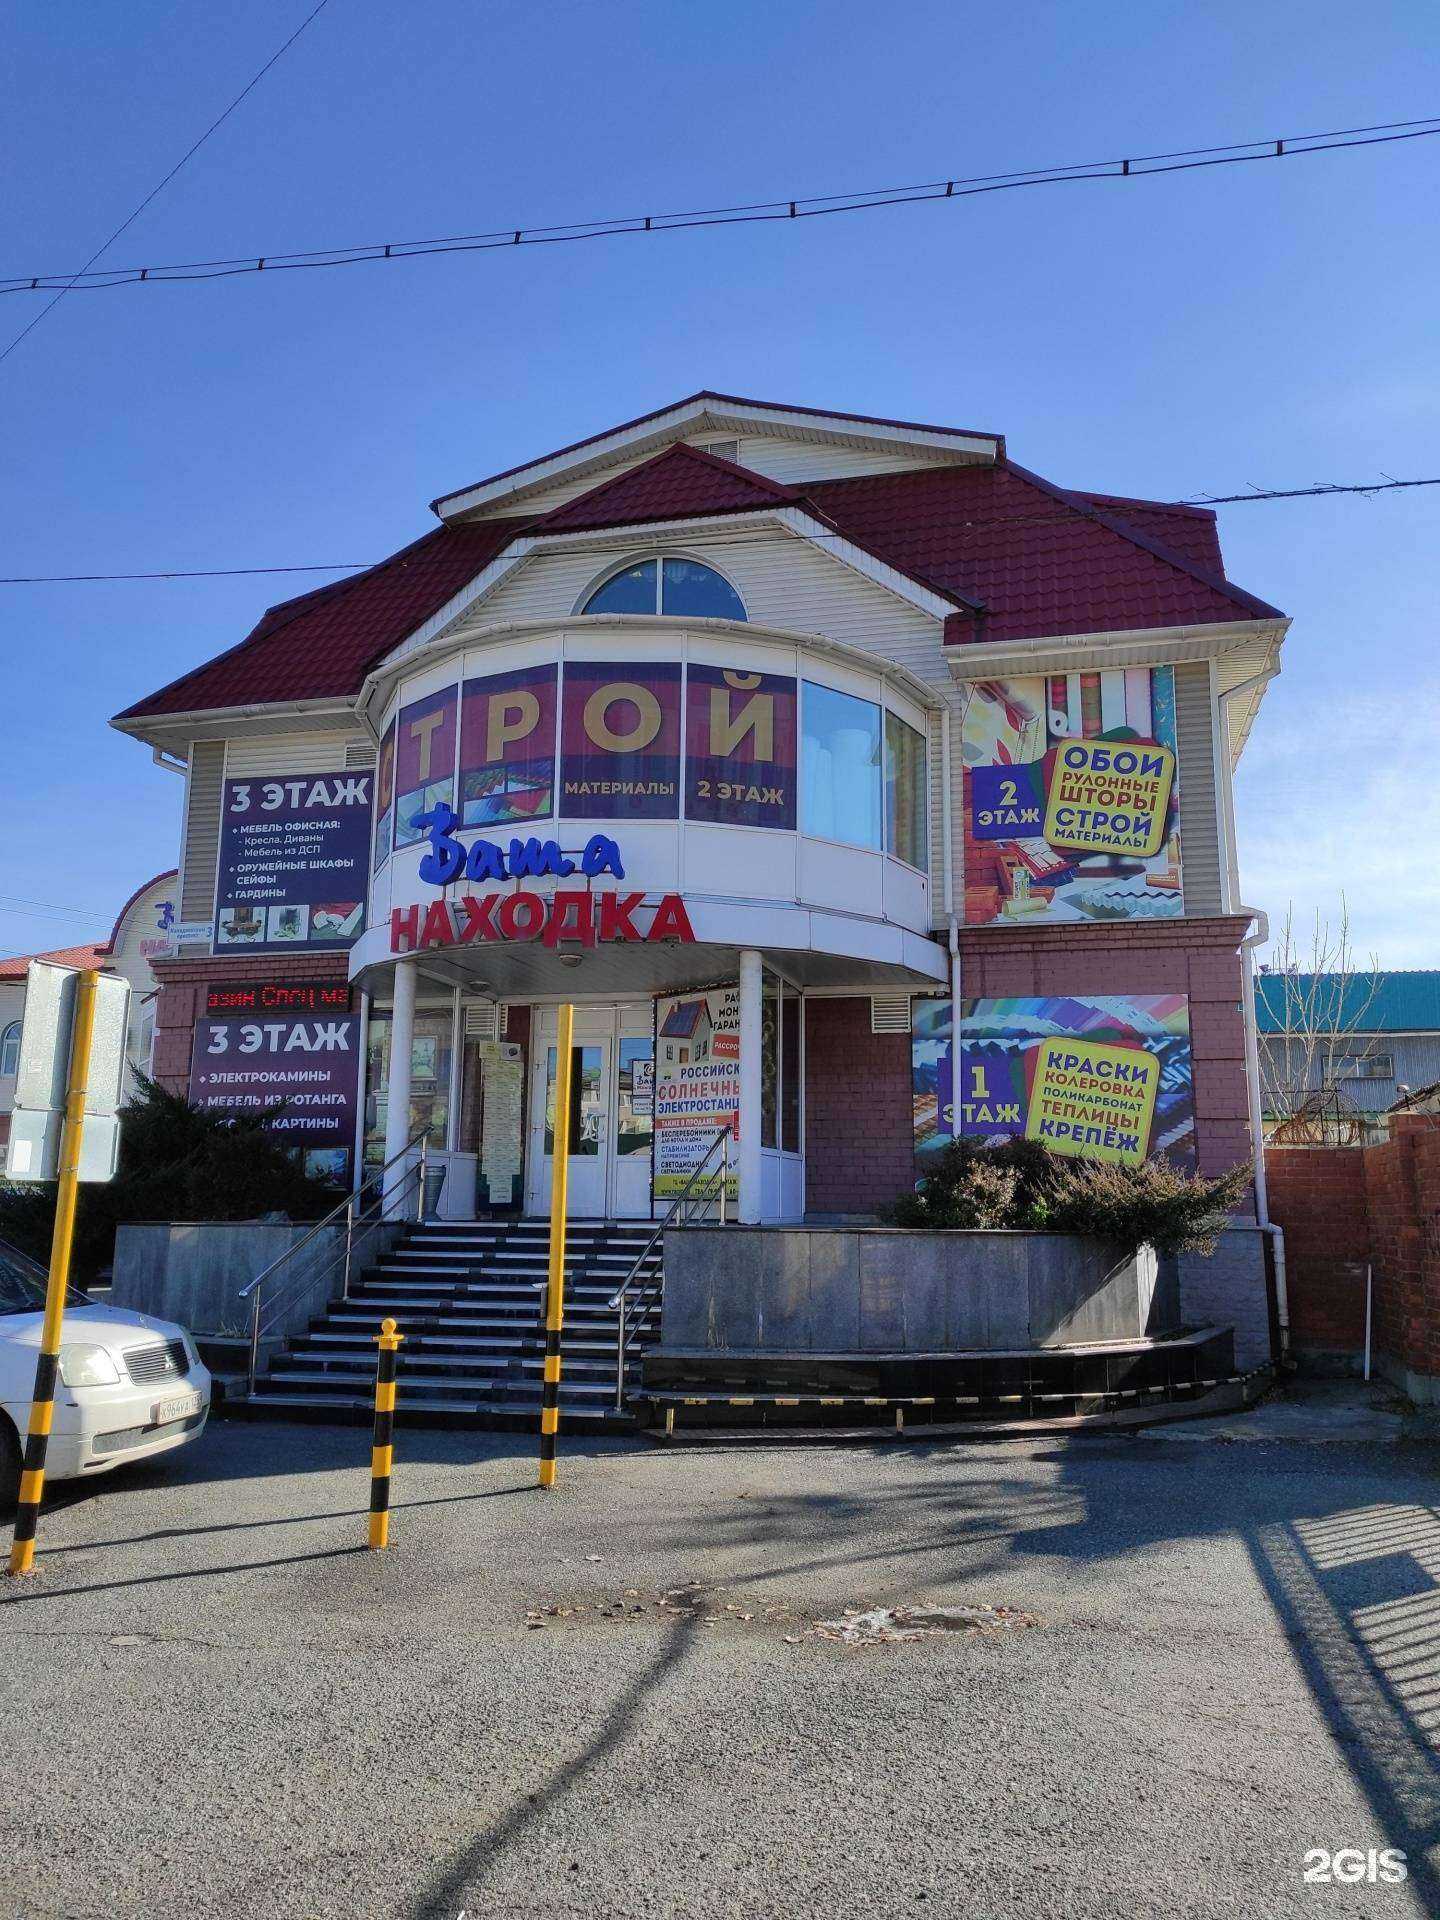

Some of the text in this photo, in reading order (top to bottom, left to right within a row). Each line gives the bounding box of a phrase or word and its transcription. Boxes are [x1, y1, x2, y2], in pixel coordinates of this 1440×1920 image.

[1064, 746, 1164, 778] ОБОИ
[565, 781, 675, 796] МАТЕРИАЛЫ
[697, 781, 785, 805] 2 ЭТАЖ
[999, 780, 1018, 806] 2
[1062, 771, 1160, 794] РУЛОННЫЕ
[230, 777, 370, 812] 3 ЭТАЖ
[1059, 784, 1157, 811] ШТОРЫ
[240, 821, 341, 834] МЕБЕЛЬ ОФИСНАЯ:
[977, 808, 1040, 826] ЭТАЖ
[1055, 807, 1152, 836] СТРОЙ
[284, 834, 324, 844] Диваны
[1054, 827, 1148, 849] МАТЕРИАЛЫ
[244, 848, 282, 857] Мебель
[298, 845, 320, 856] ДСП
[237, 859, 354, 872] ОРУЖЕЙНЫЕ ШКАФЫ
[236, 874, 277, 885] СЕЙФЫ
[235, 888, 286, 899] ГАРДИНЫ
[390, 891, 697, 953] НАХОДКА
[207, 1022, 351, 1054] 3 ЭТАЖ
[714, 1042, 740, 1050] РАССРО
[208, 1070, 331, 1083] ЭЛЕКТРОКАМИНЫ
[1047, 1051, 1149, 1084] КРАСКИ
[971, 1066, 990, 1098] 1
[1044, 1071, 1146, 1100] КОЛЕРОВКА
[207, 1095, 261, 1107] МЕБЕЛЬ
[1043, 1086, 1142, 1112] ПОЛИКАРБОНАТ
[271, 1117, 339, 1129] КАРТИНЫ
[1041, 1100, 1140, 1129] ТЕПЛИЦЫ
[1039, 1119, 1140, 1153] КРЕПЁЖ
